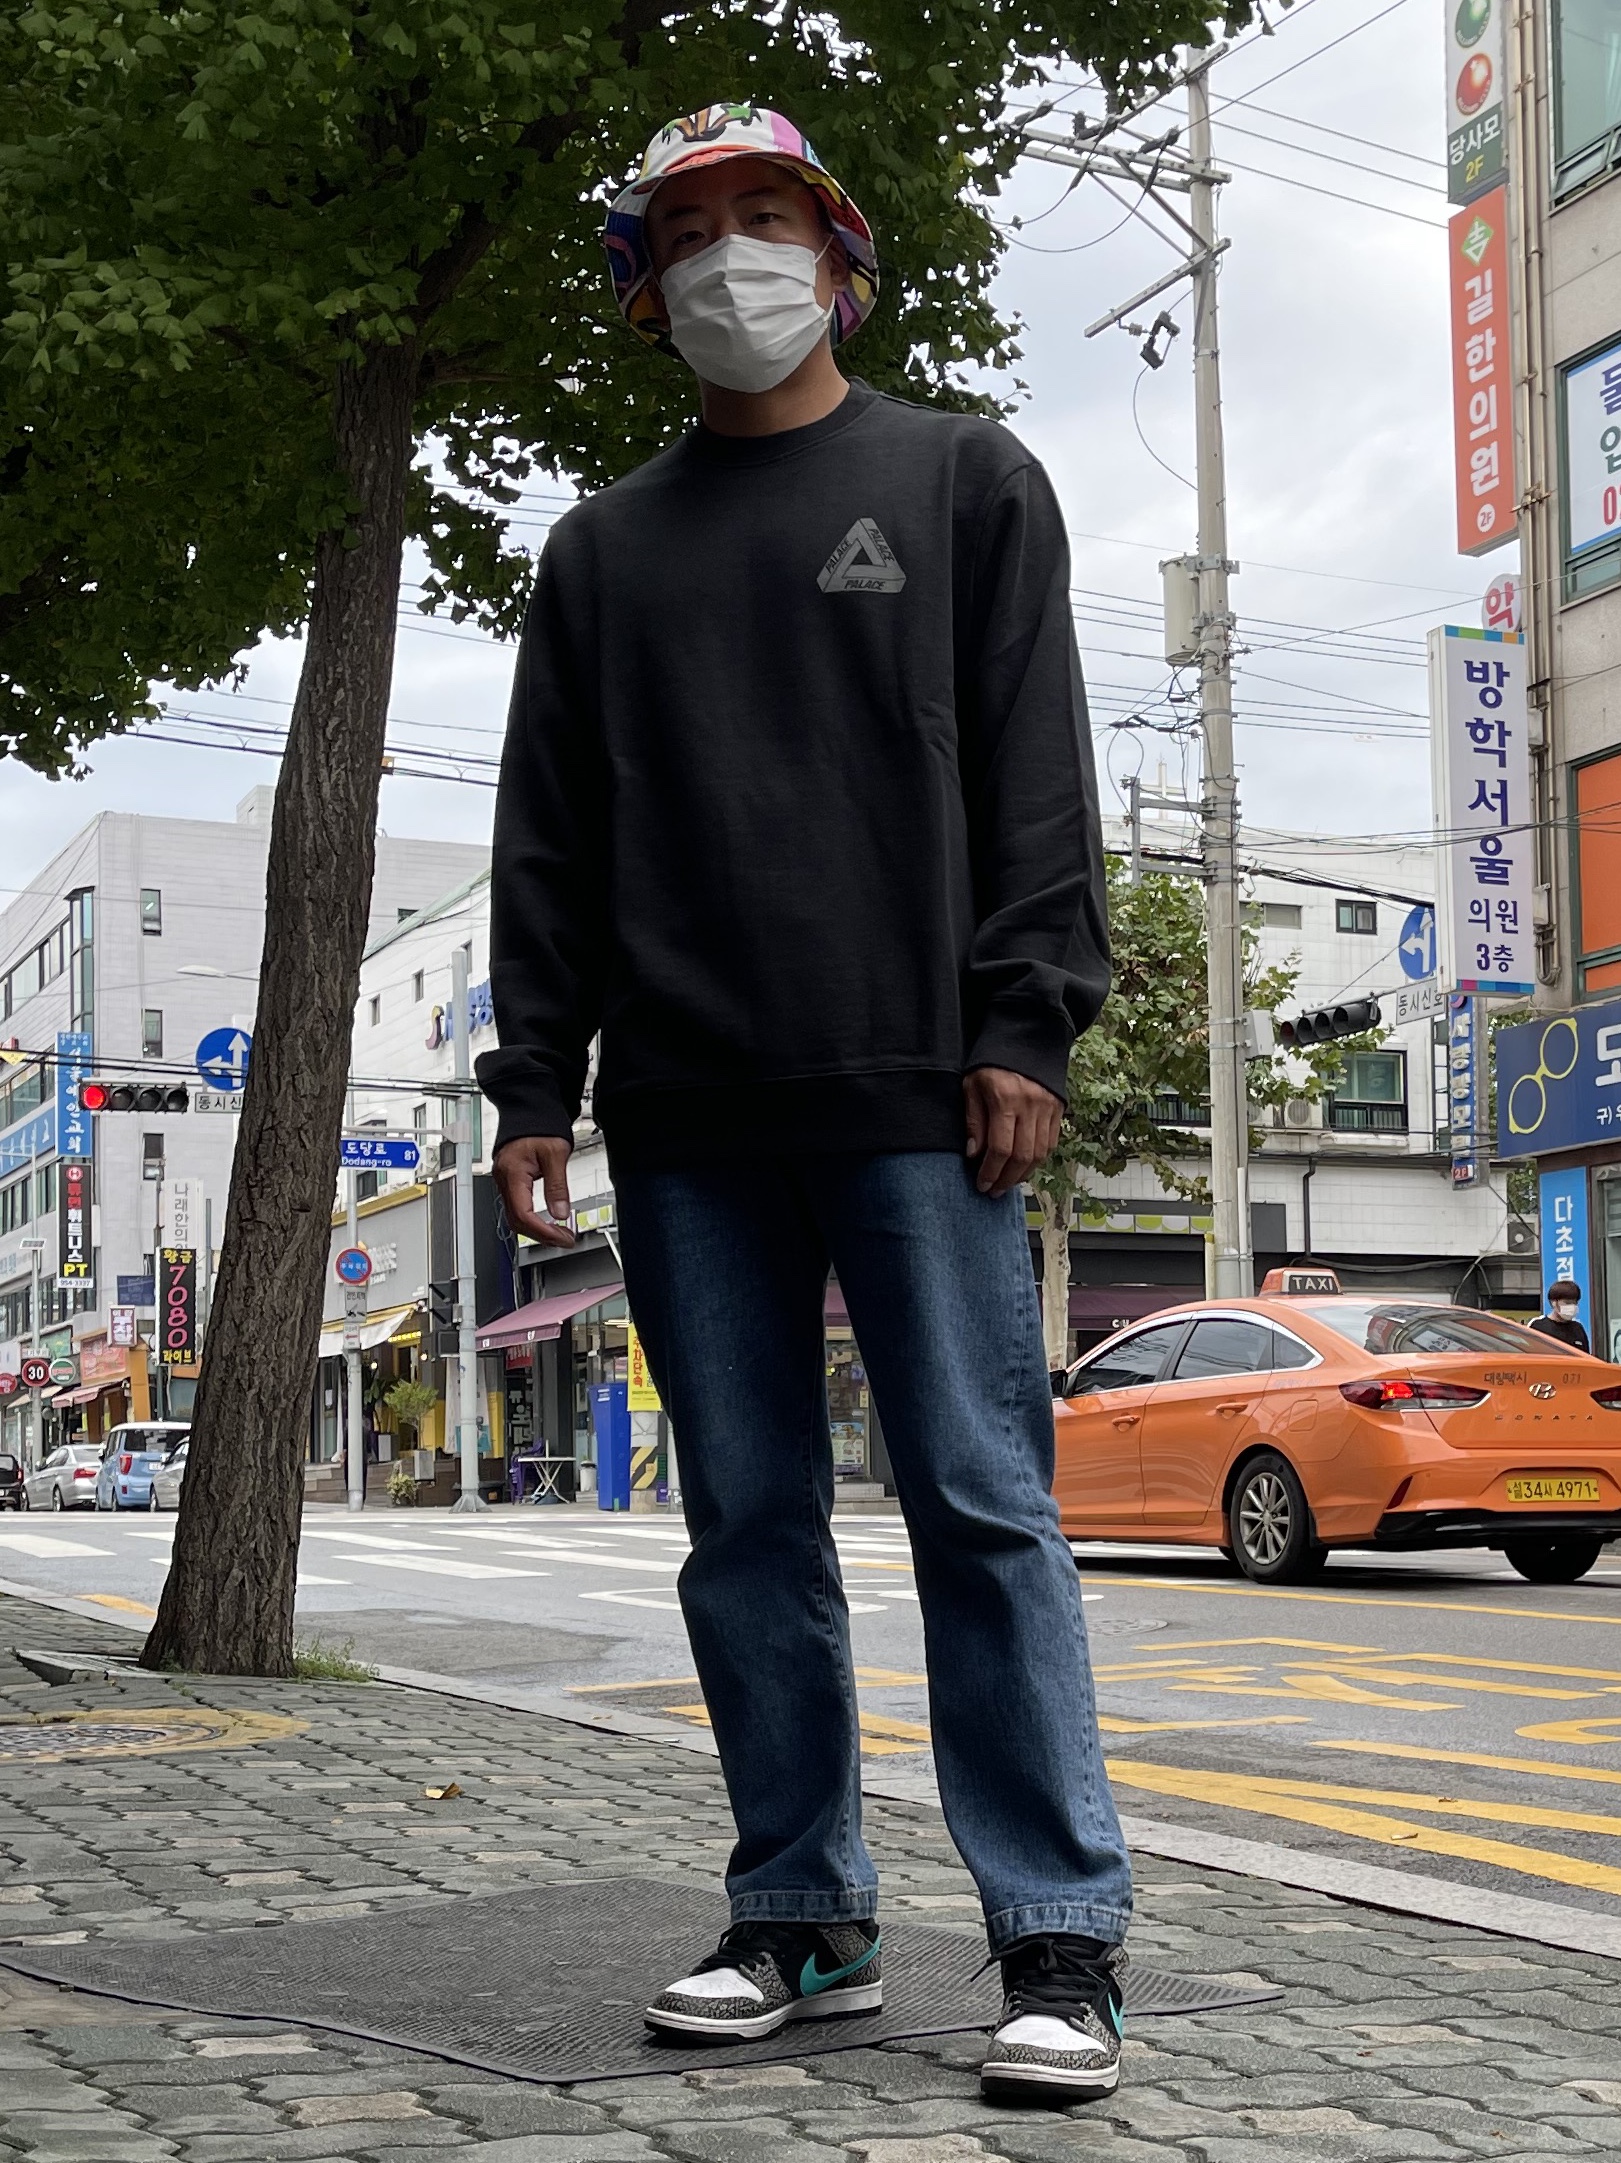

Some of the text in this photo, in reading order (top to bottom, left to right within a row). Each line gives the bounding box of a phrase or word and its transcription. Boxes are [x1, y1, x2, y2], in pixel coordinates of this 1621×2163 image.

[1450, 114, 1500, 165] 당사모
[1466, 154, 1484, 183] 2F
[1465, 268, 1499, 497] 길한의원
[1480, 510, 1492, 527] 2F
[868, 528, 895, 561] PALACE
[825, 539, 852, 574] PALACE
[844, 579, 885, 590] PALACE
[1486, 581, 1514, 630] 약
[1476, 943, 1514, 973] 3층
[345, 1141, 416, 1161] 도당로 81
[341, 1156, 392, 1168] Dodang-ro
[1453, 1167, 1468, 1179] 2F
[64, 1263, 88, 1277] PT
[1291, 1276, 1334, 1291] TAXI
[167, 1265, 188, 1348] 7080
[1112, 1319, 1130, 1329] CU
[163, 1350, 192, 1364] 라이브
[28, 1366, 44, 1380] 30
[1556, 1481, 1592, 1498] 4971
